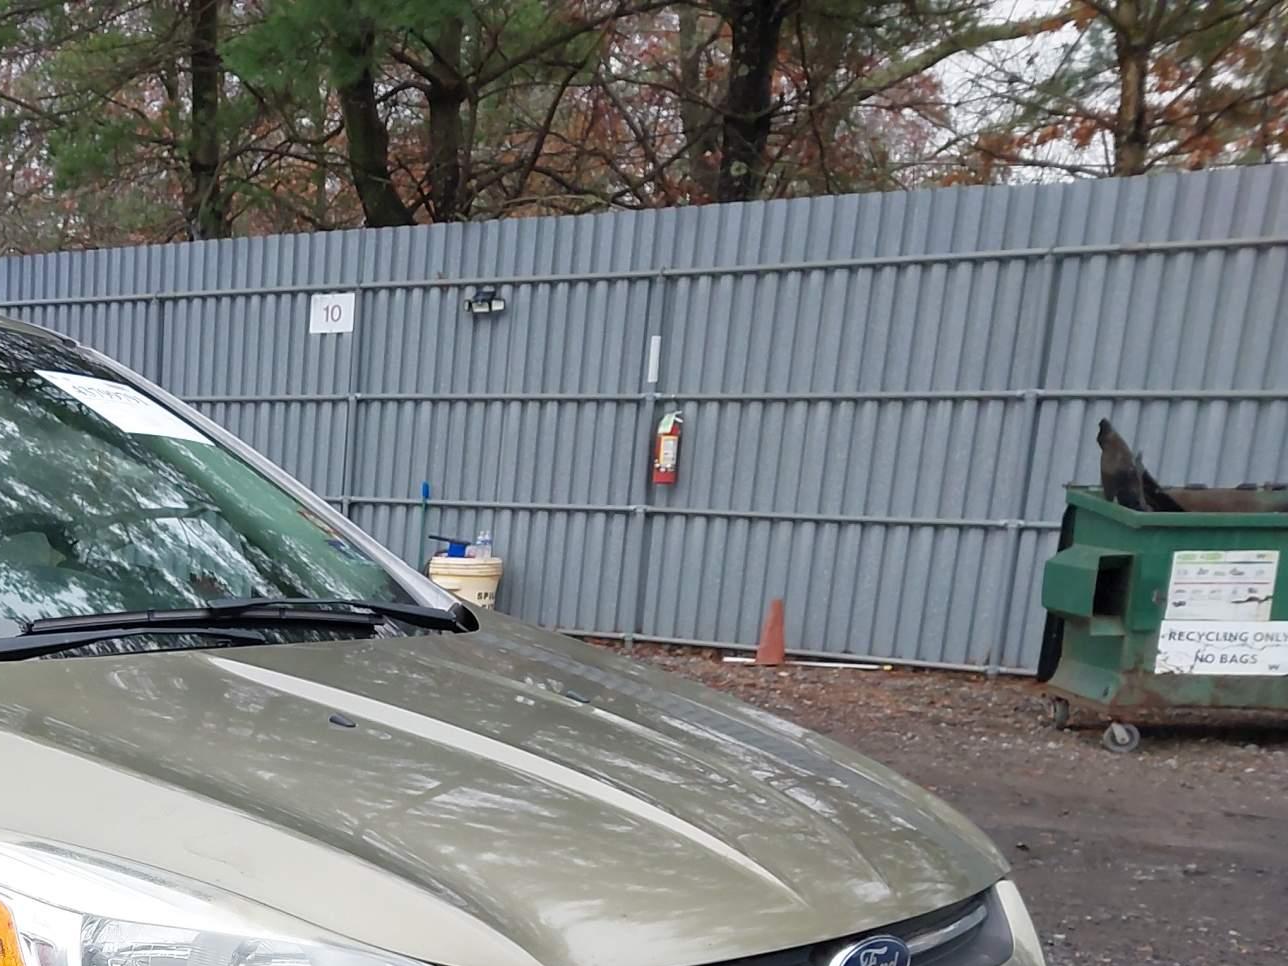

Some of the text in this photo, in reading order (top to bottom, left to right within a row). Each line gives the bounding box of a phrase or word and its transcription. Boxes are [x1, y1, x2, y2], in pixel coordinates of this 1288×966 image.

[323, 304, 342, 322] 10
[1168, 631, 1248, 643] RECYCLING
[1194, 653, 1258, 665] NO BAGS
